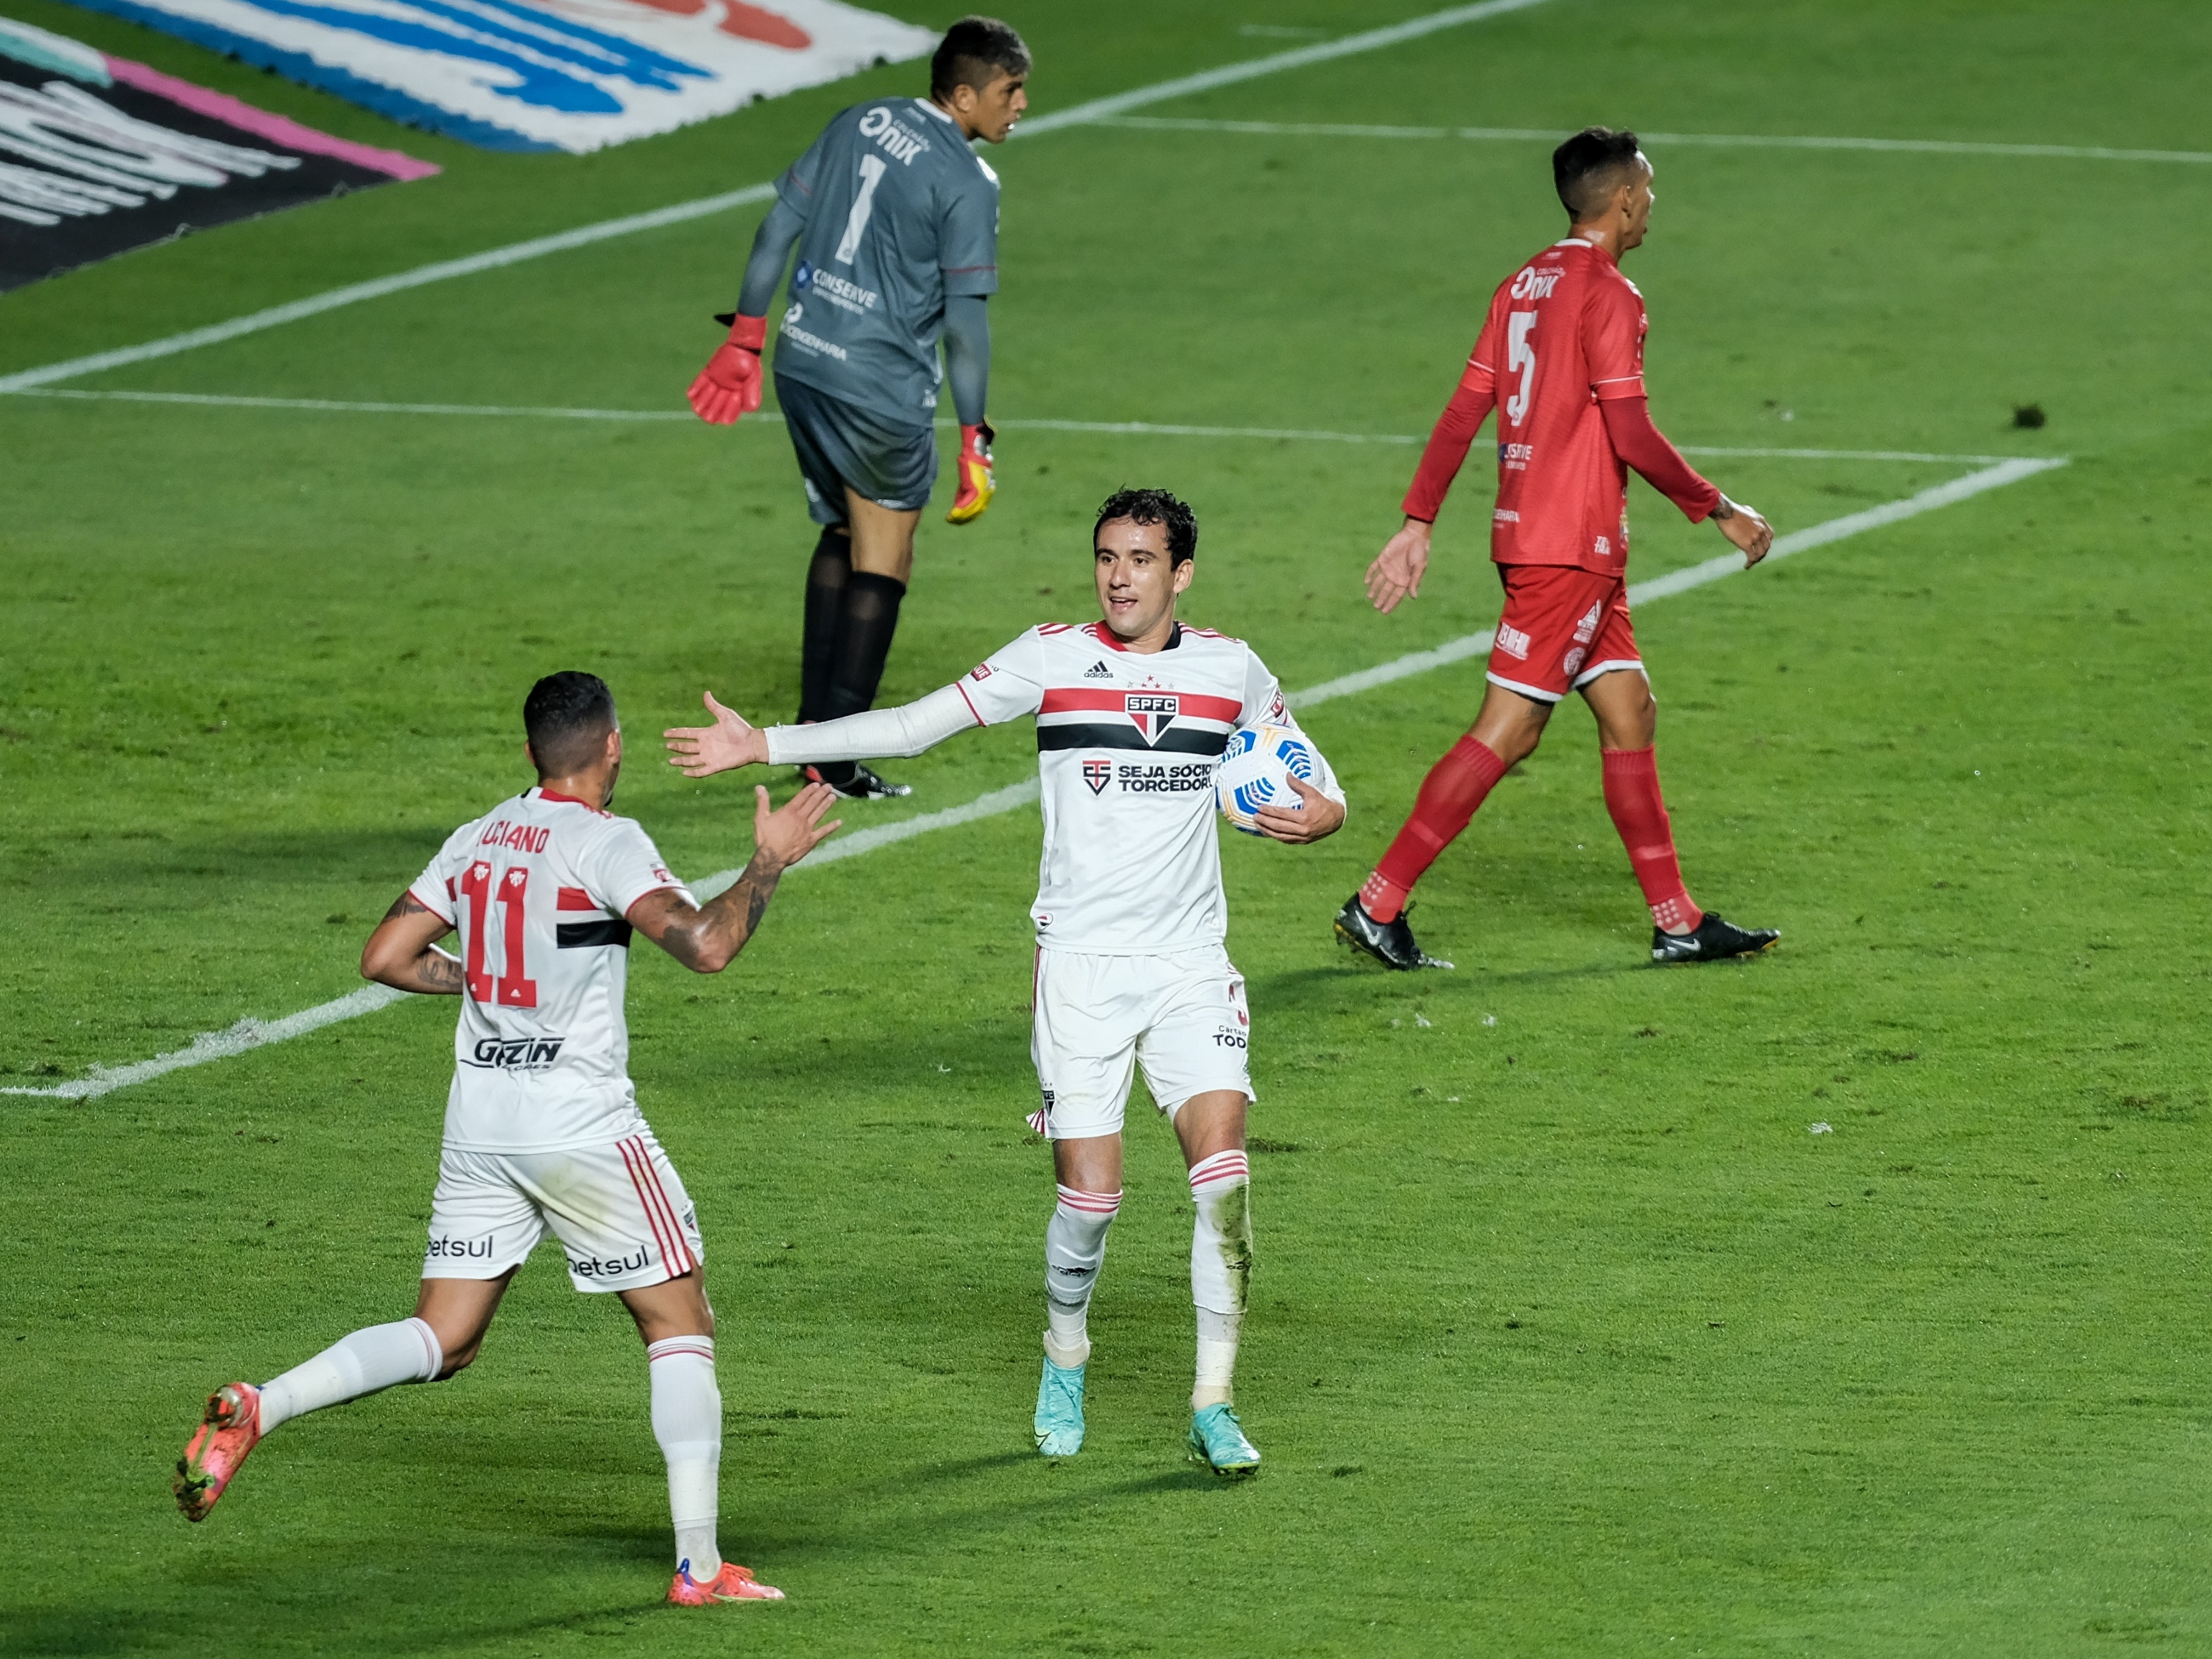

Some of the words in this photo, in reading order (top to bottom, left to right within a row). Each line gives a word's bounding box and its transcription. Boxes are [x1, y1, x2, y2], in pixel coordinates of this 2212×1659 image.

[835, 153, 887, 265] 1
[812, 268, 878, 308] CONSERVE
[1506, 309, 1539, 427] 5
[1129, 698, 1175, 711] SPFC
[1118, 765, 1166, 778] SEJA
[1118, 775, 1213, 792] TORCEDOR!
[461, 859, 538, 1009] 11
